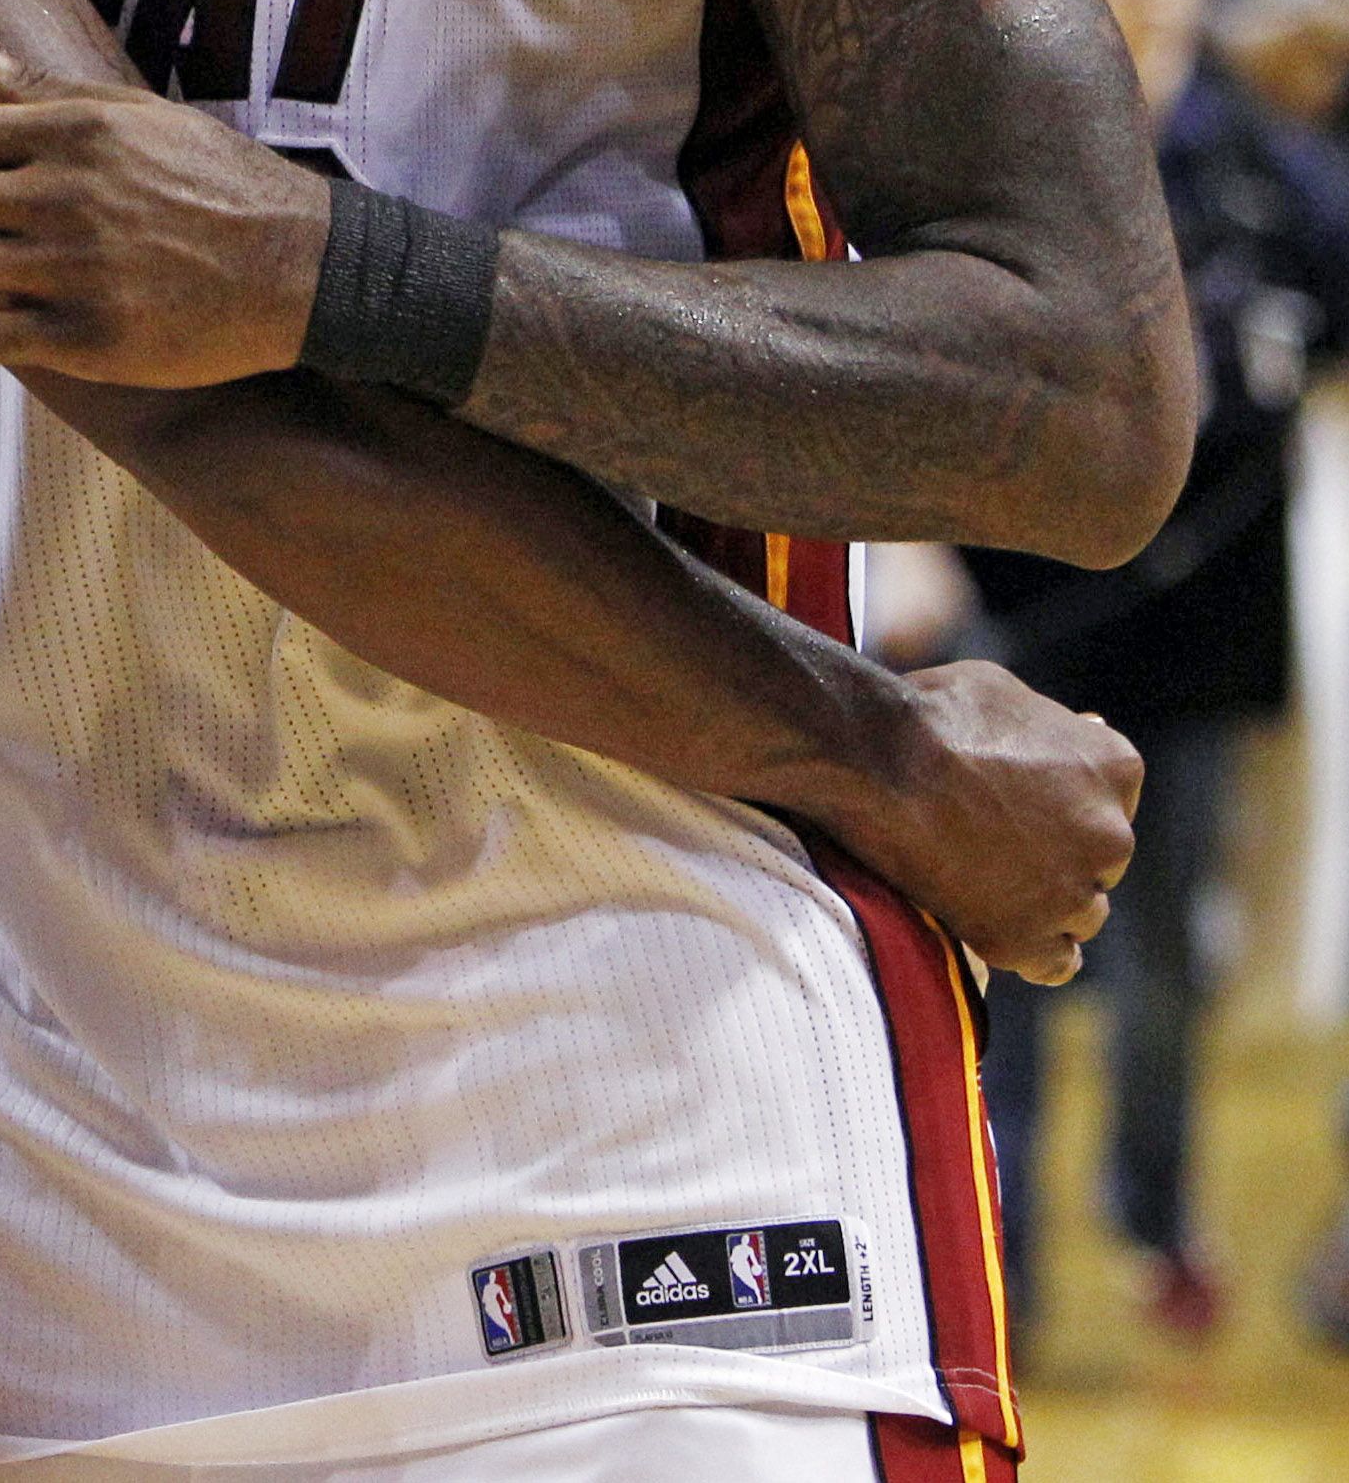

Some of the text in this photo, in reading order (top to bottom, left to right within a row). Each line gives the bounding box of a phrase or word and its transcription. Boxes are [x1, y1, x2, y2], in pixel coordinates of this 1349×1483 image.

[783, 1249, 836, 1277] 2XL
[635, 1282, 711, 1306] adidas
[859, 1265, 874, 1322] LENGTH
